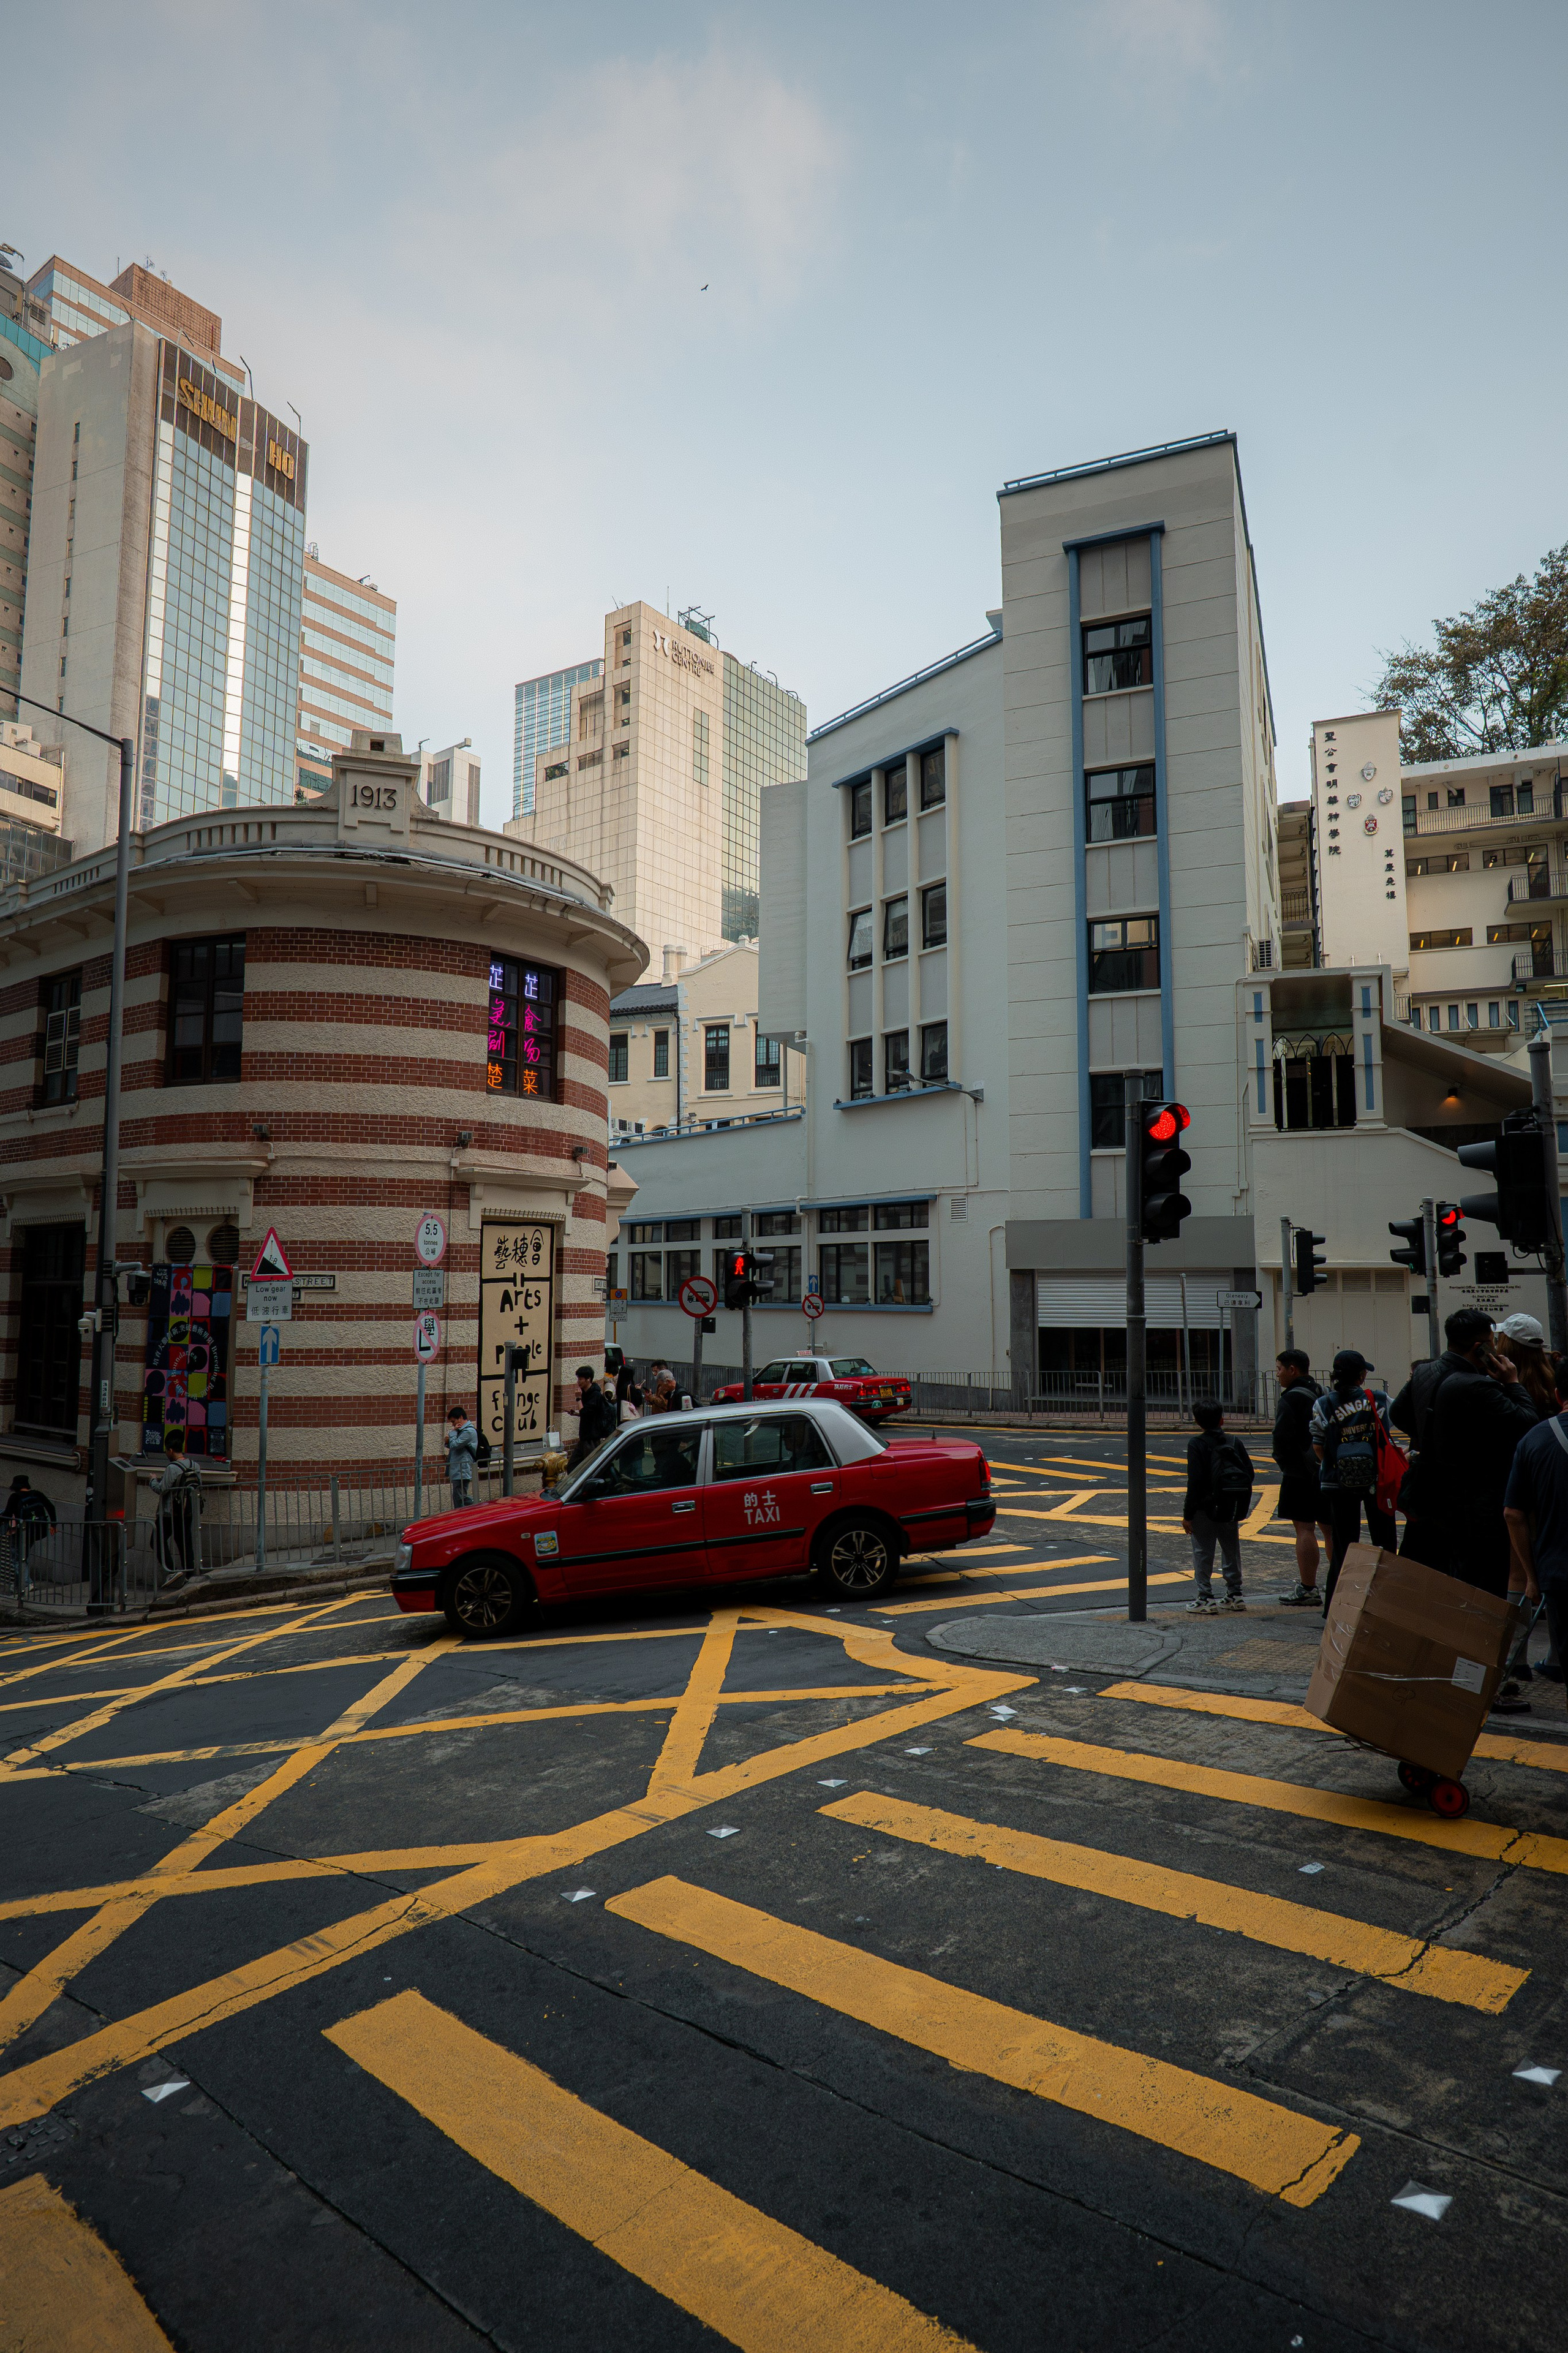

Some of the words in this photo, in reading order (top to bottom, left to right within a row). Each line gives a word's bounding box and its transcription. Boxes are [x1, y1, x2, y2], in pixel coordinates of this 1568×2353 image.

[179, 377, 237, 445] SHUN
[269, 438, 294, 480] HO
[671, 652, 701, 678] CENTRE
[672, 639, 714, 674] RUTTONJEE
[351, 784, 397, 810] 1913
[1325, 731, 1341, 855] 聖公會明華神學院
[425, 1223, 438, 1236] 5.5
[269, 1255, 277, 1264] 1:8
[251, 1305, 288, 1316] 低波行車
[500, 1288, 541, 1312] Arts
[744, 1490, 777, 1508] 的士
[744, 1506, 780, 1525] TAXI
